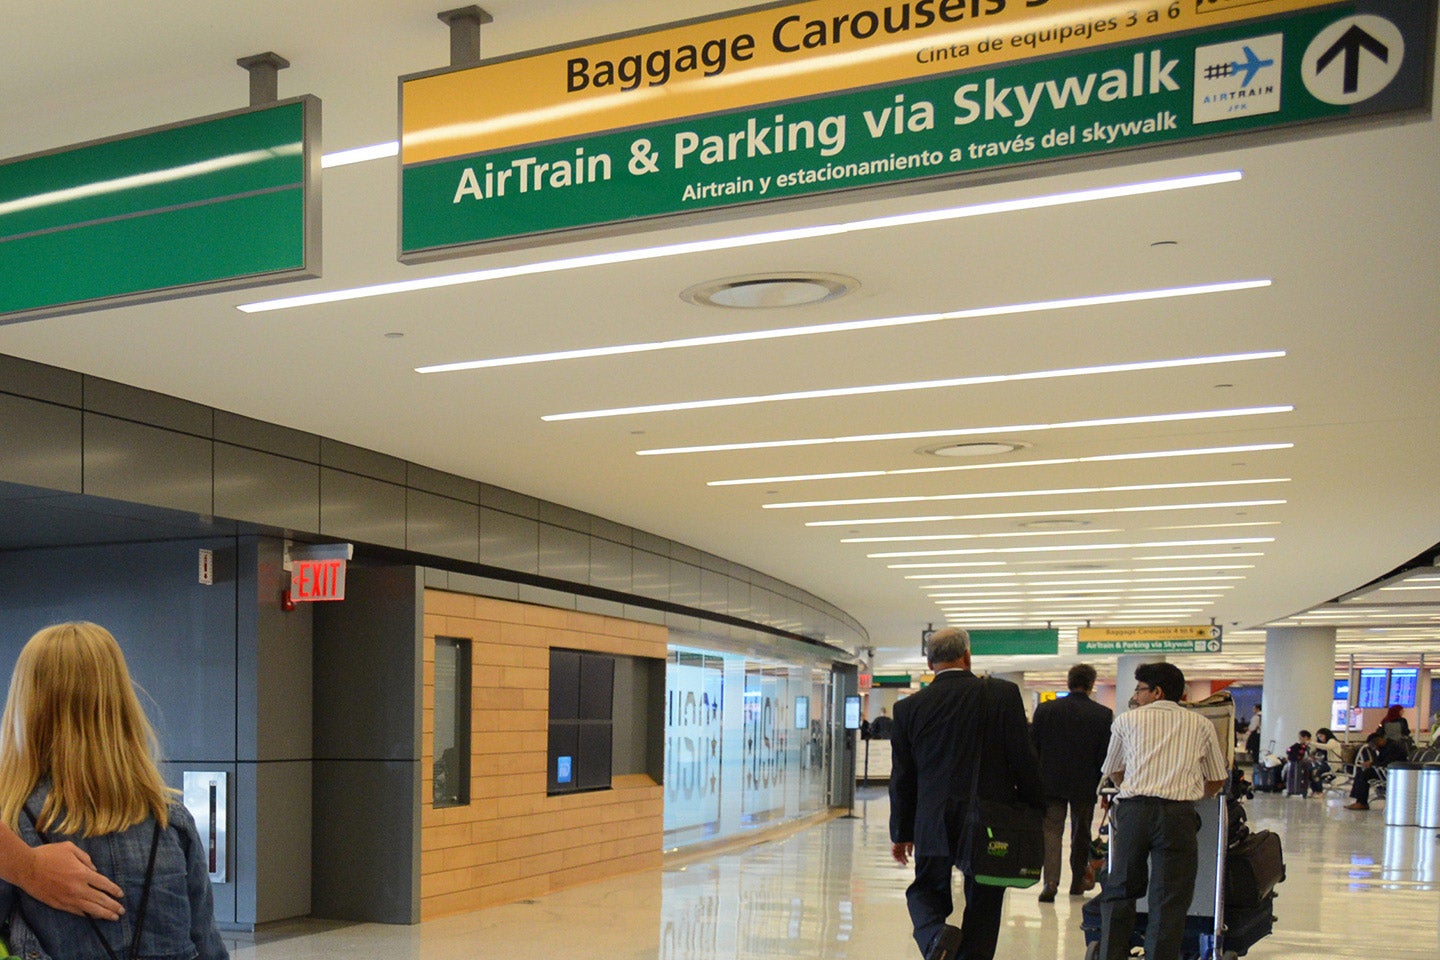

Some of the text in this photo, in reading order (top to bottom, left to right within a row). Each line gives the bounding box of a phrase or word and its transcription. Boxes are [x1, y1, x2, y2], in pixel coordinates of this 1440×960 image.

[567, 32, 755, 93] Baggage
[916, 1, 1181, 64] Cinta de equipajes 3 a 6
[1203, 86, 1274, 104] AIRTRAIN
[1228, 104, 1248, 112] JFK
[452, 52, 1181, 204] AirTrain & Parking via Skywalk
[682, 111, 1178, 202] Airtrain y estacionamiento a través del skywalk
[299, 562, 341, 598] EXIT
